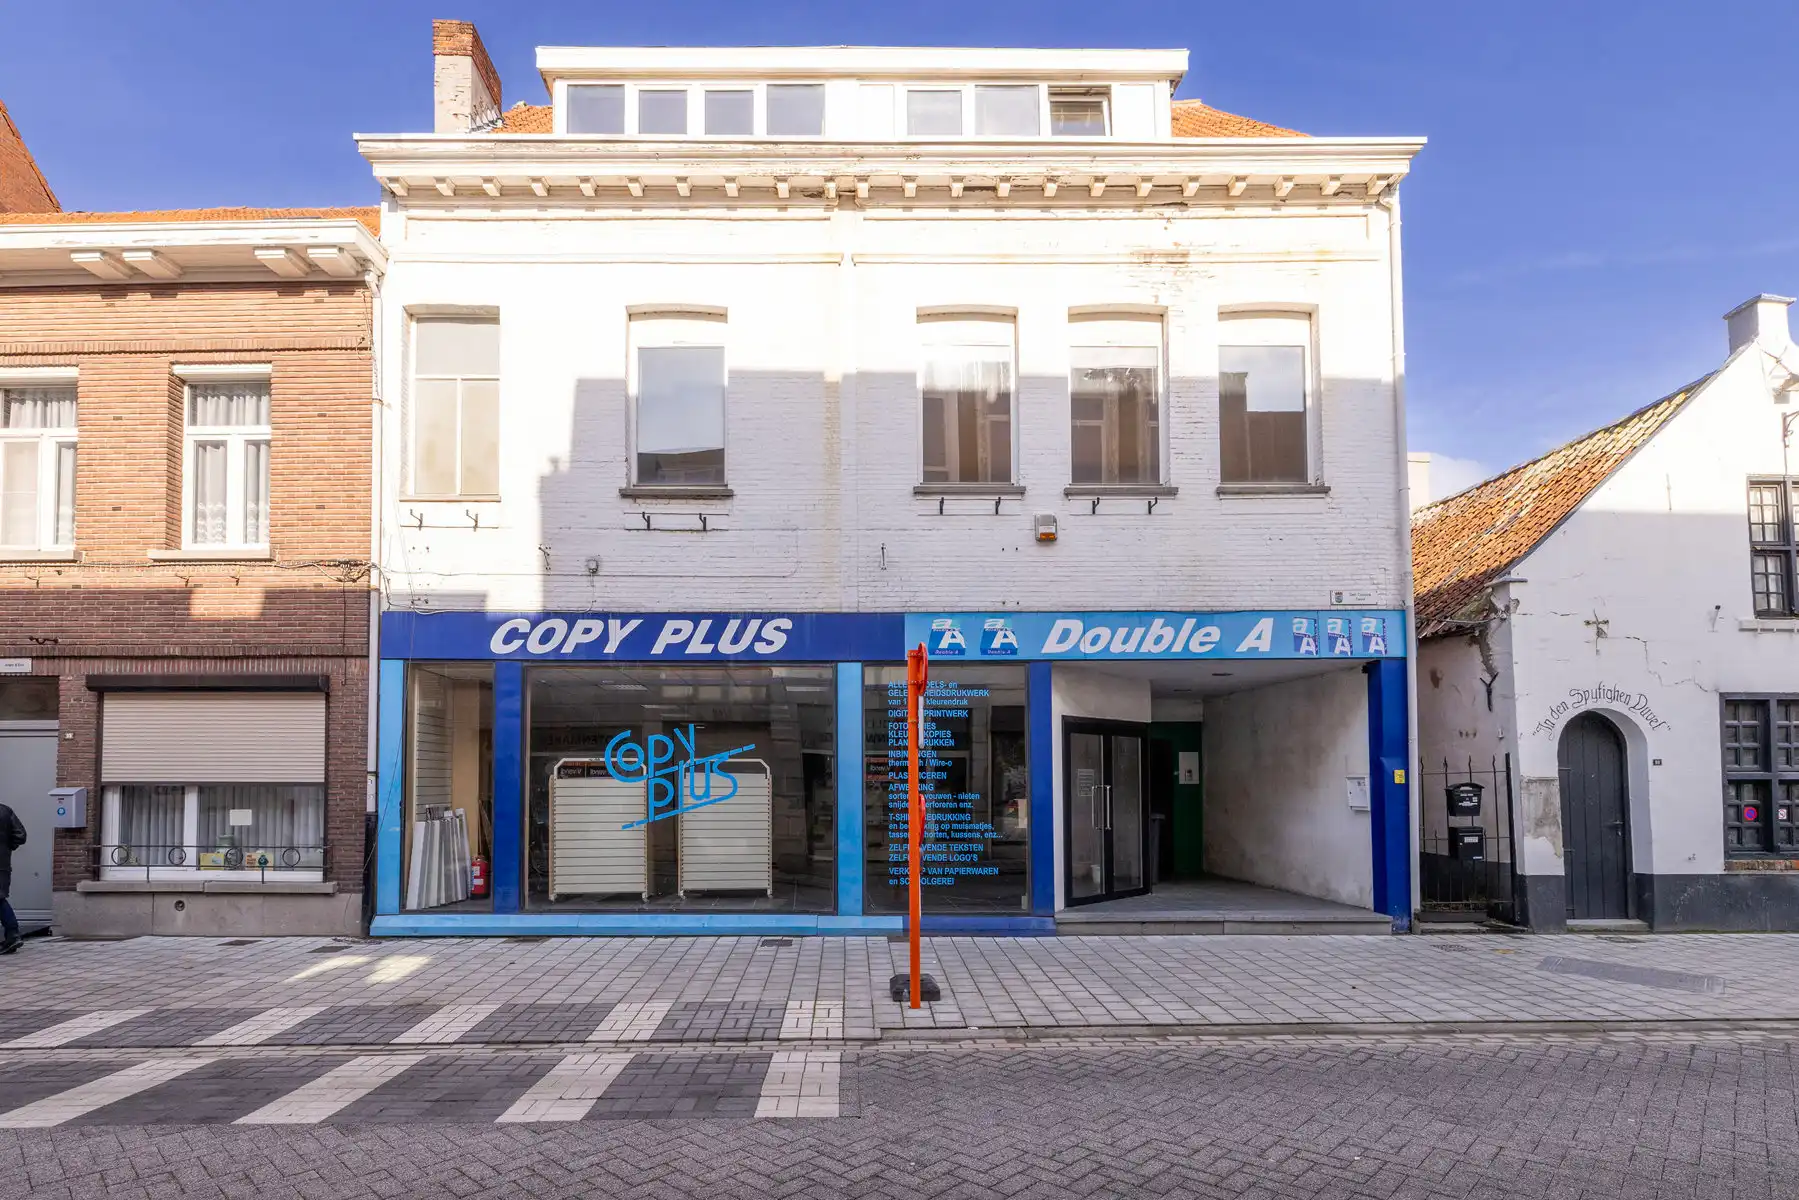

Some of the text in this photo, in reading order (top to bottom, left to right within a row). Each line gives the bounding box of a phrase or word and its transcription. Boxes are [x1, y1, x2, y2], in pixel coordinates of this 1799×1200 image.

[490, 618, 792, 655] COPY PLUS
[1040, 618, 1221, 654] Double
[1236, 618, 1274, 653] A
[1550, 701, 1568, 720] den
